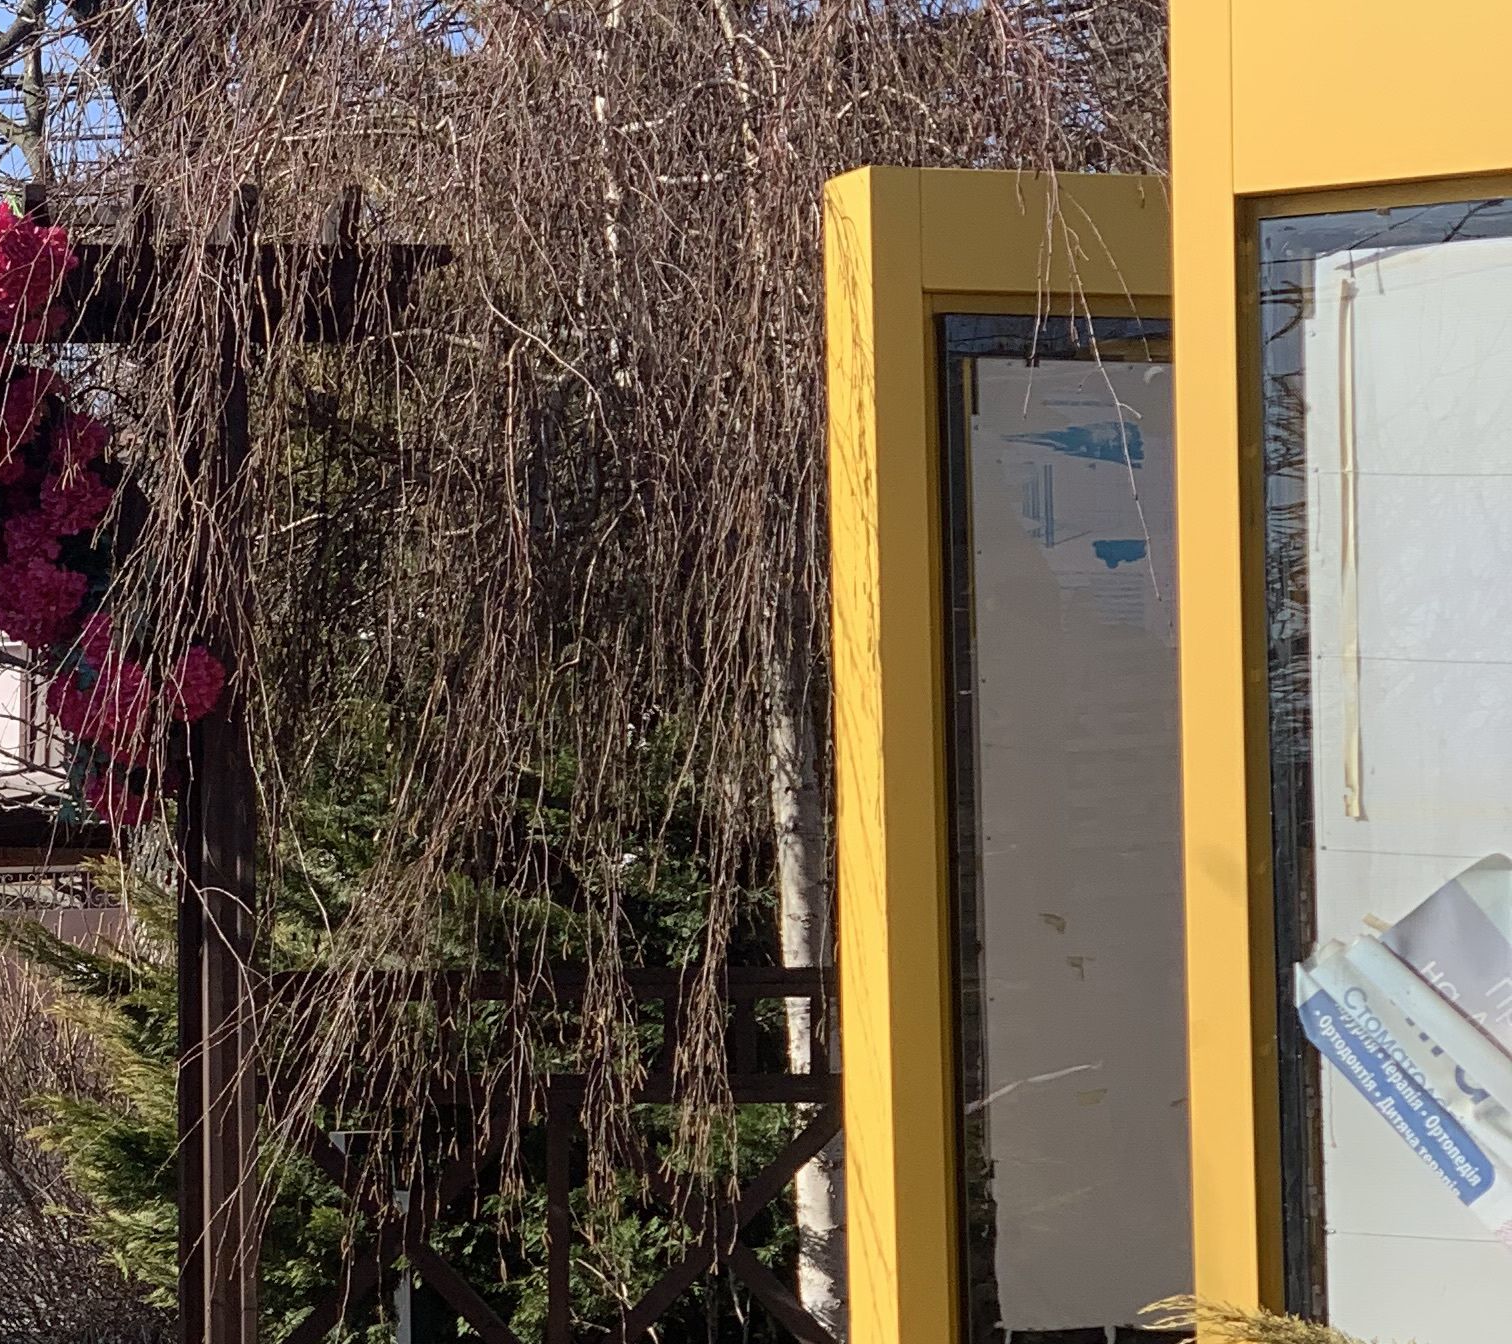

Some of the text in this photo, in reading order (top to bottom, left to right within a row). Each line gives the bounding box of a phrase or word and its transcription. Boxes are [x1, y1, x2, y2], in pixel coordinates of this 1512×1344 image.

[1319, 1014, 1378, 1092] Ортодонтія
[1377, 1097, 1419, 1149] Дитяча
[1424, 1115, 1482, 1187] Ортопедія
